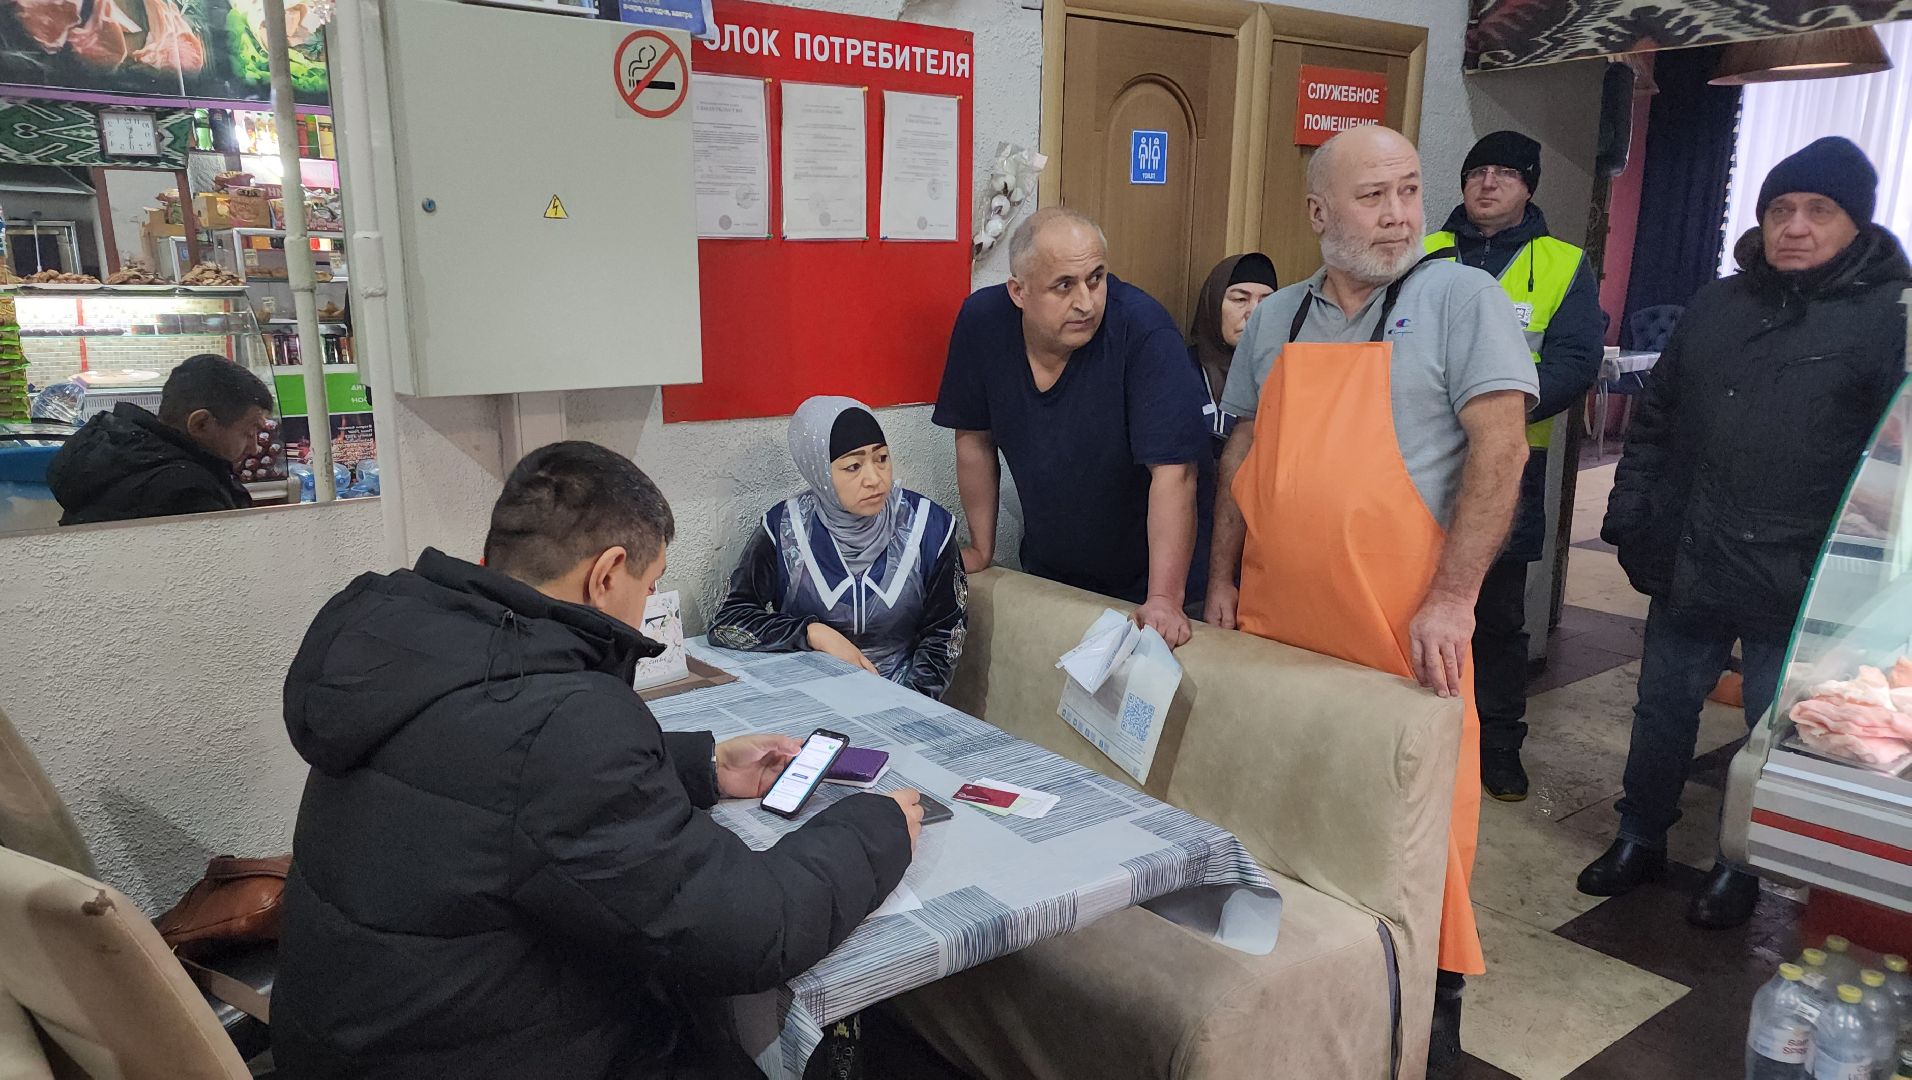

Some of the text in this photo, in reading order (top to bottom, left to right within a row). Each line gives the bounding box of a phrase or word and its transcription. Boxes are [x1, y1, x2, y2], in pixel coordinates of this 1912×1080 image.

[703, 23, 969, 78] ОЛОК ПОТРЕБИТЕЛЯ
[1307, 82, 1379, 104] СЛУЖЕБНОЕ
